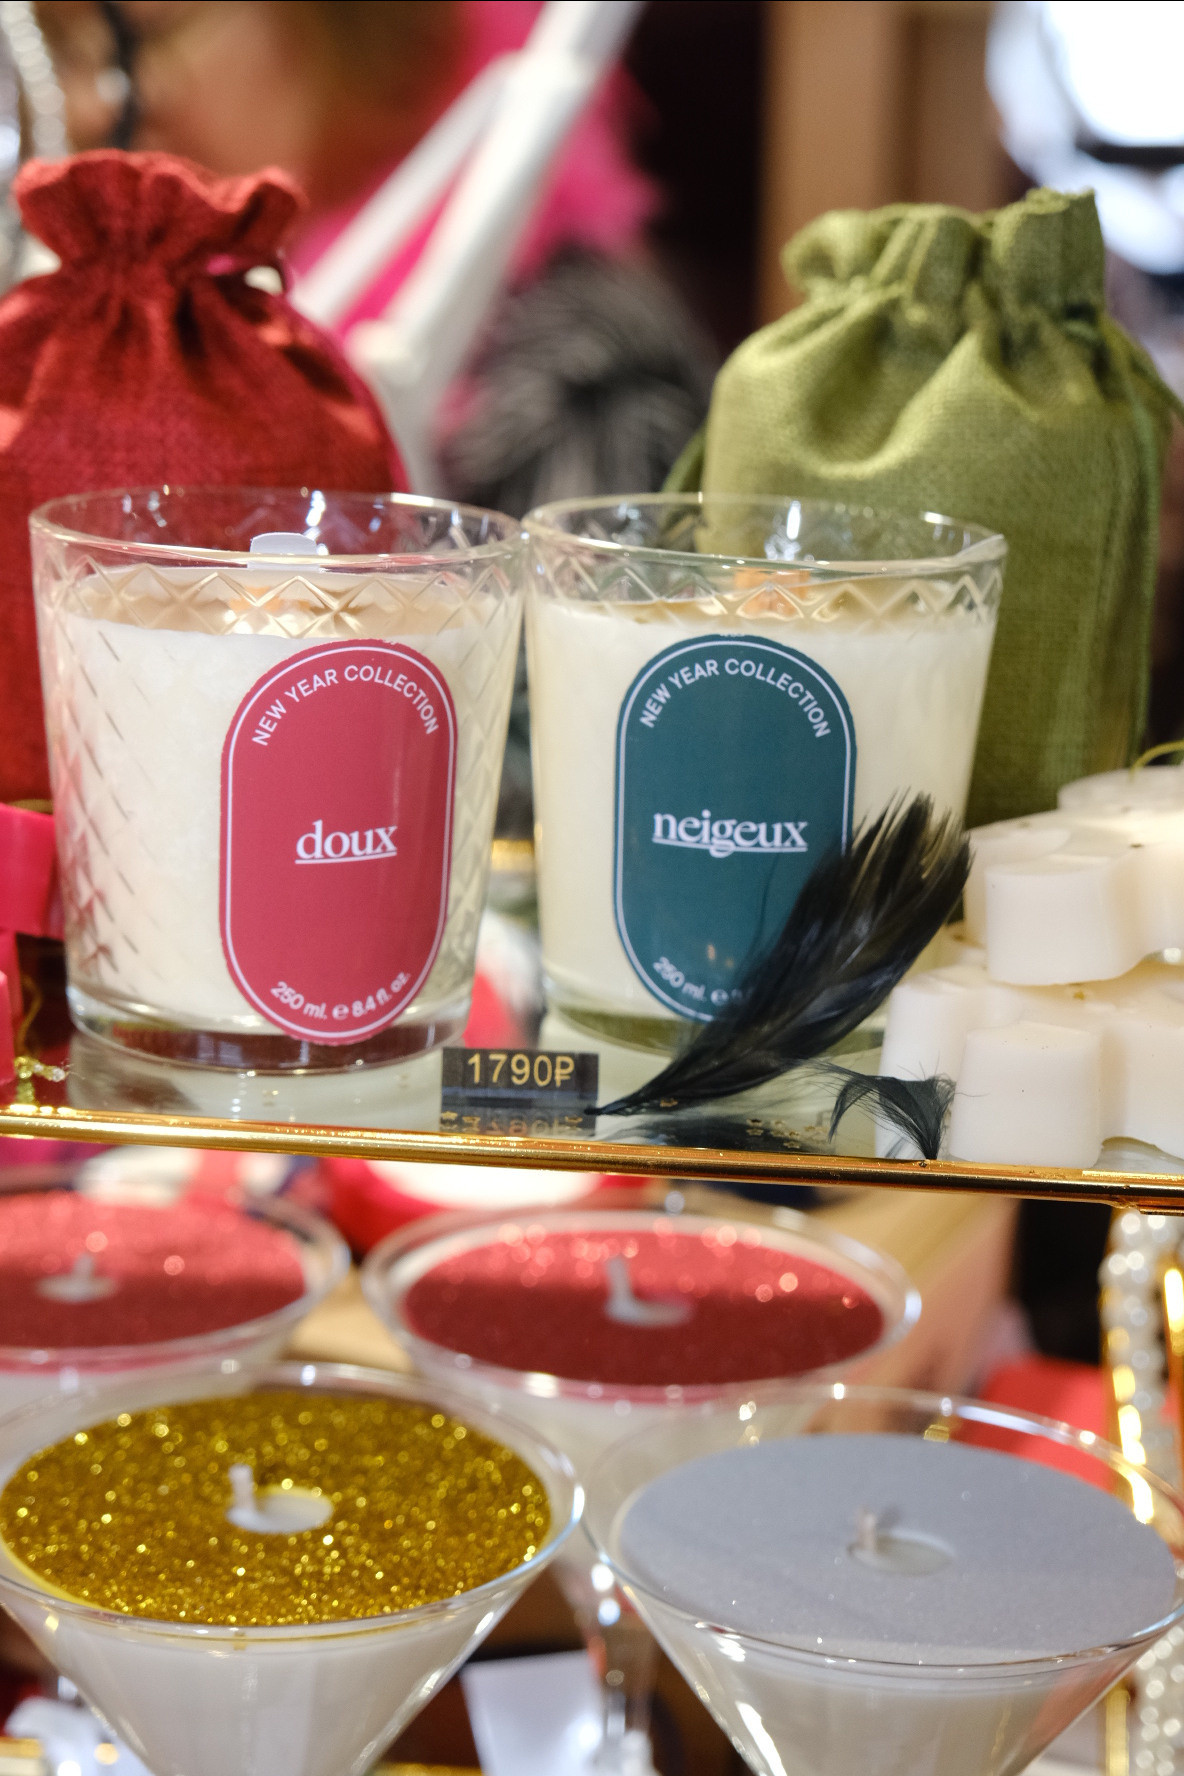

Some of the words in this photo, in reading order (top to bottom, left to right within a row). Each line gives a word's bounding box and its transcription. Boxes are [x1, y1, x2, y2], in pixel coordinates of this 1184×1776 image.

[252, 699, 286, 746] NEW
[284, 668, 339, 703] YEAR
[344, 664, 439, 735] COLLECTION
[639, 683, 671, 728] NEW
[668, 659, 720, 690] YEAR
[724, 658, 831, 738] COLLECTION
[296, 819, 398, 864] doux
[652, 809, 809, 858] neigeux
[270, 981, 304, 1010] 250
